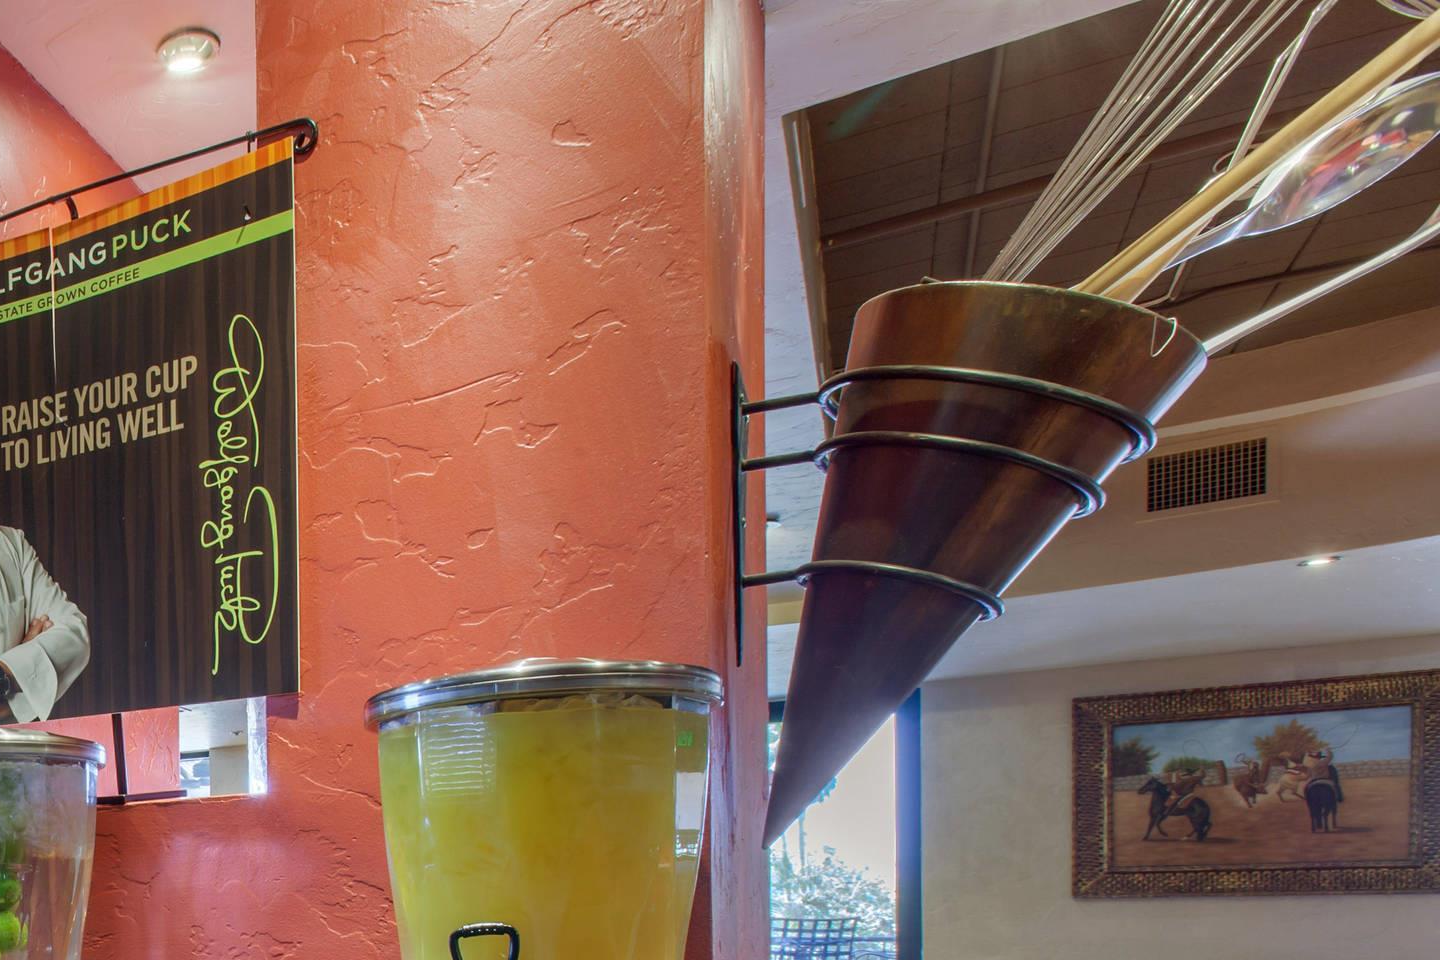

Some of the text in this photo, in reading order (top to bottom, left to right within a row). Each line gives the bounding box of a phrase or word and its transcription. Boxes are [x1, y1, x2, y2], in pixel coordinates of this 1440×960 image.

[37, 285, 87, 310] GROWN
[90, 267, 140, 294] COFFEE
[1, 355, 198, 436] RAISE YOUR CUP
[199, 314, 264, 549] Wolfgang
[0, 399, 185, 471] TO LIVING WELL
